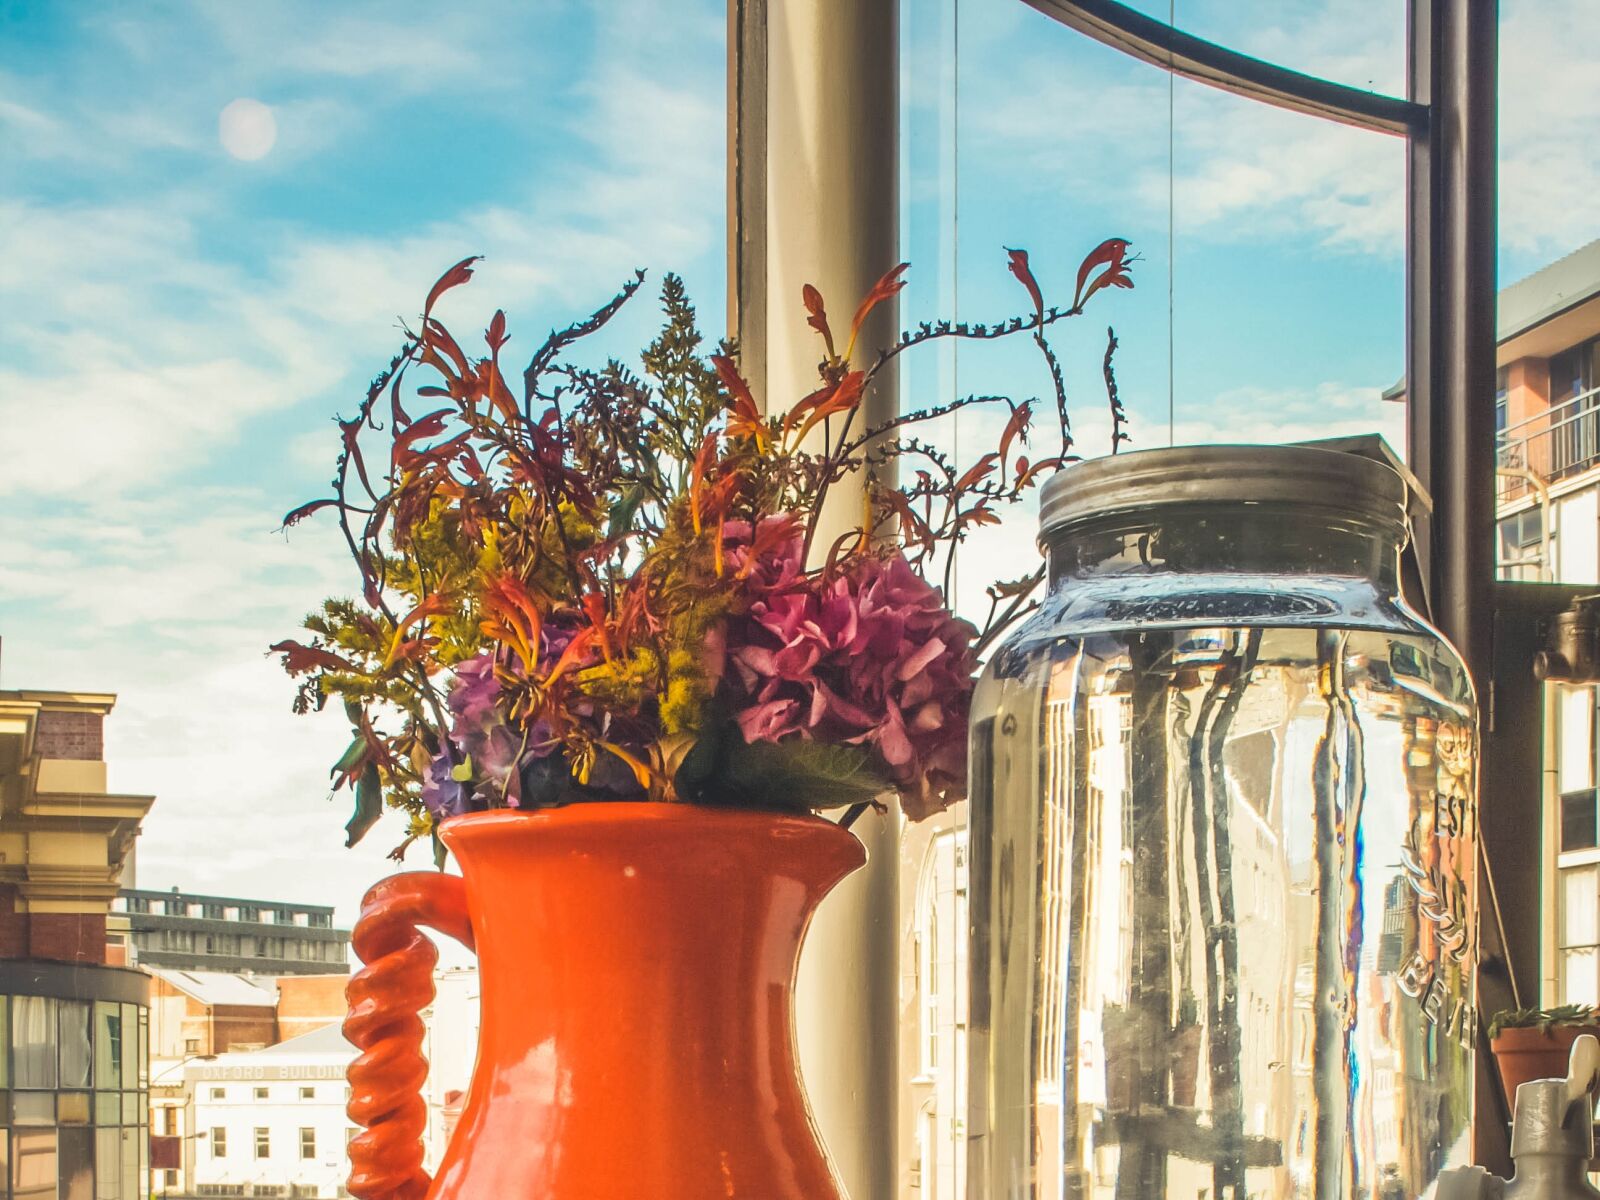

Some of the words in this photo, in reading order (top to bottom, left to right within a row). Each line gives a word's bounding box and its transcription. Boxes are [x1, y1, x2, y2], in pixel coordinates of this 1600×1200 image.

[1434, 793, 1465, 838] EST
[202, 1066, 264, 1080] OXFORD
[279, 1065, 346, 1080] BUILDIN
